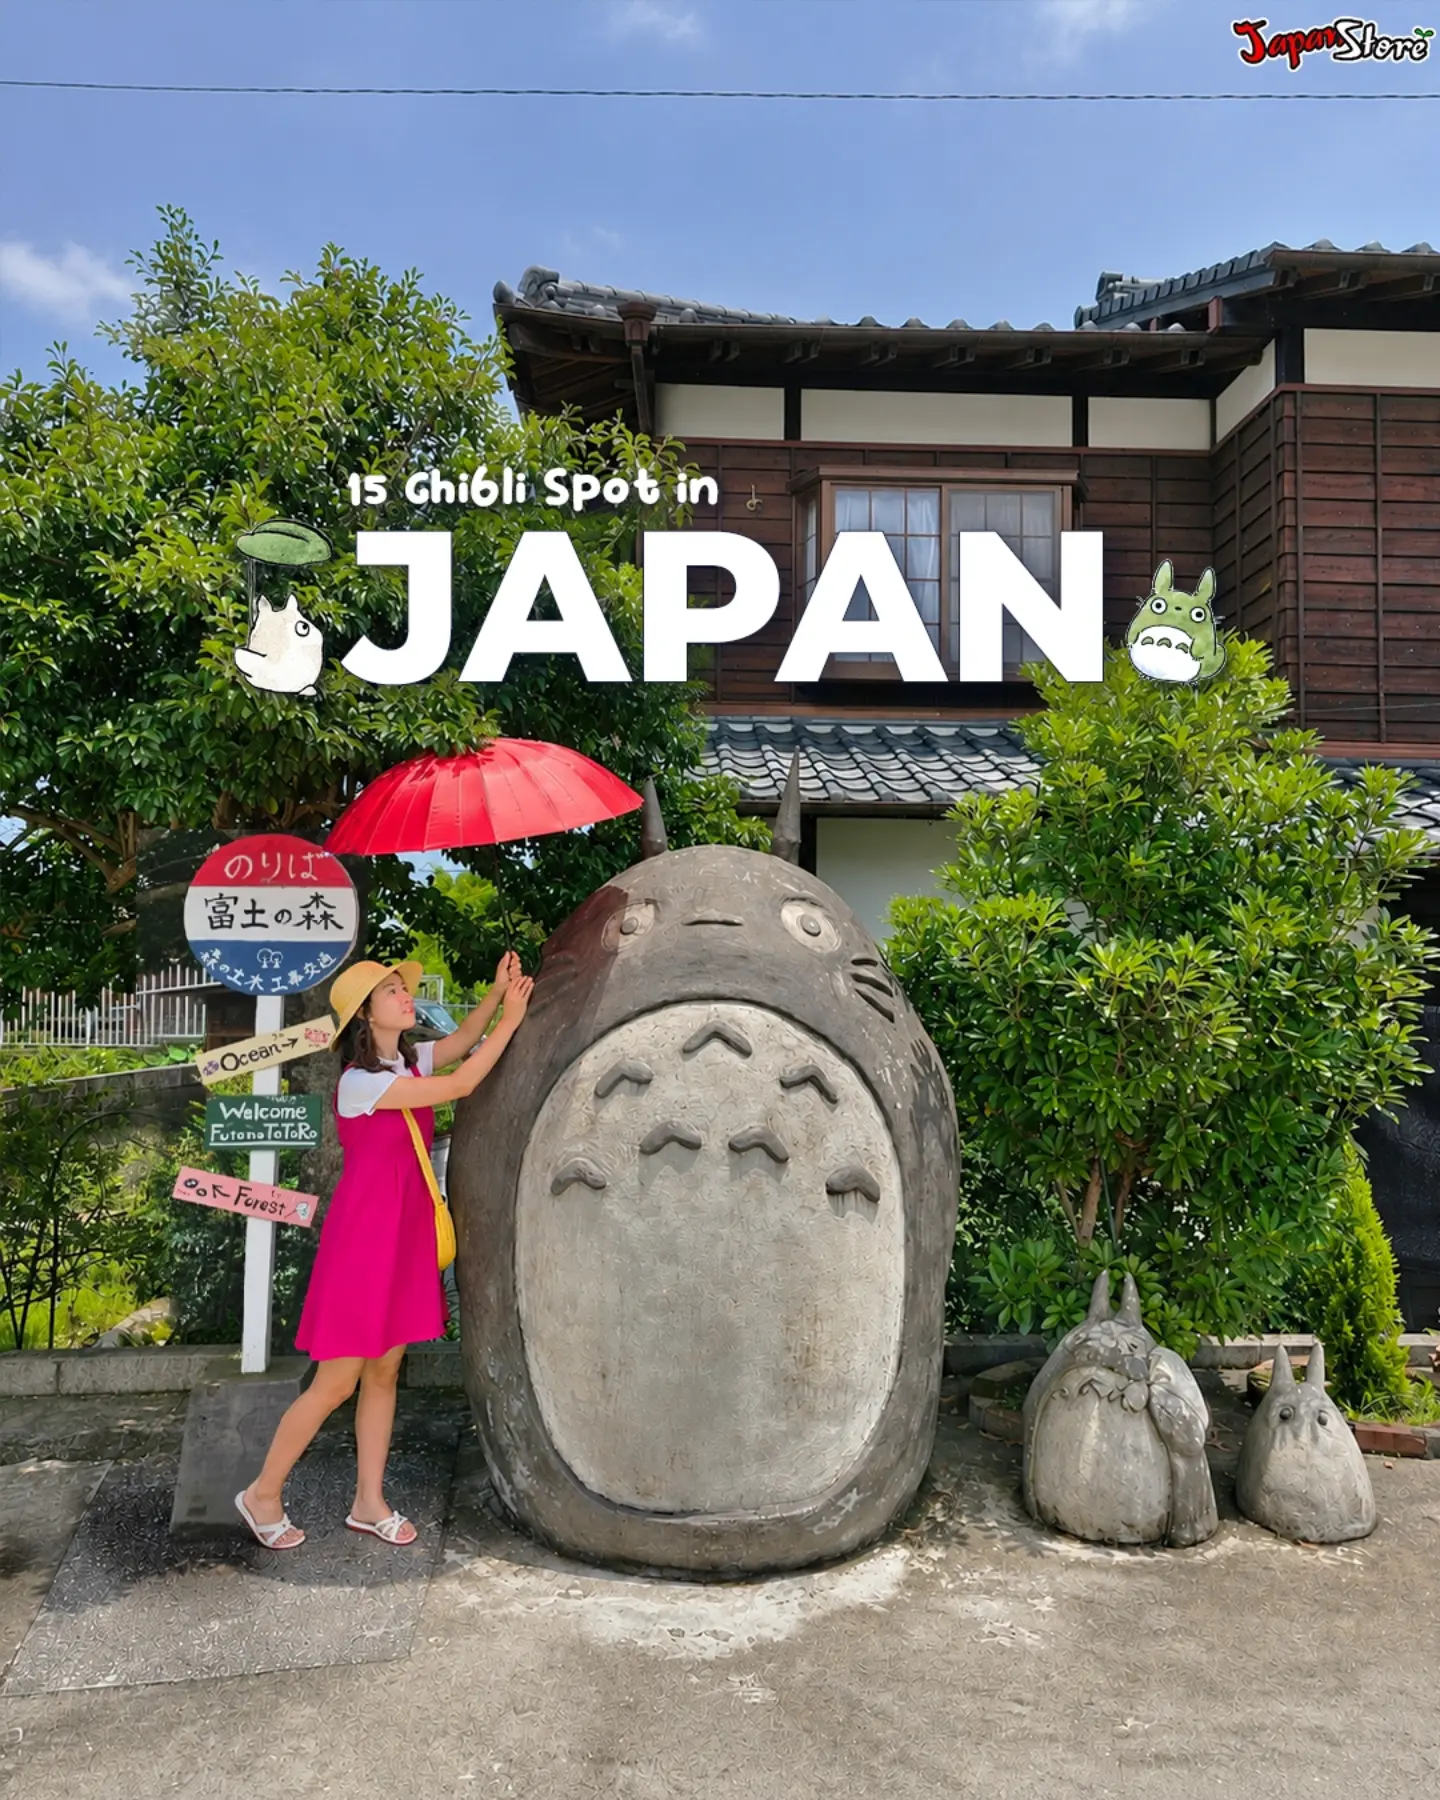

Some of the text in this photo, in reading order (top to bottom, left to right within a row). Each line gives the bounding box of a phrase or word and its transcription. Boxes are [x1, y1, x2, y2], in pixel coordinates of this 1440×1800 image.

[224, 851, 330, 882] のりば
[220, 1042, 282, 1072] Ocean
[219, 1101, 308, 1122] Welcome
[233, 1185, 286, 1216] Forest
